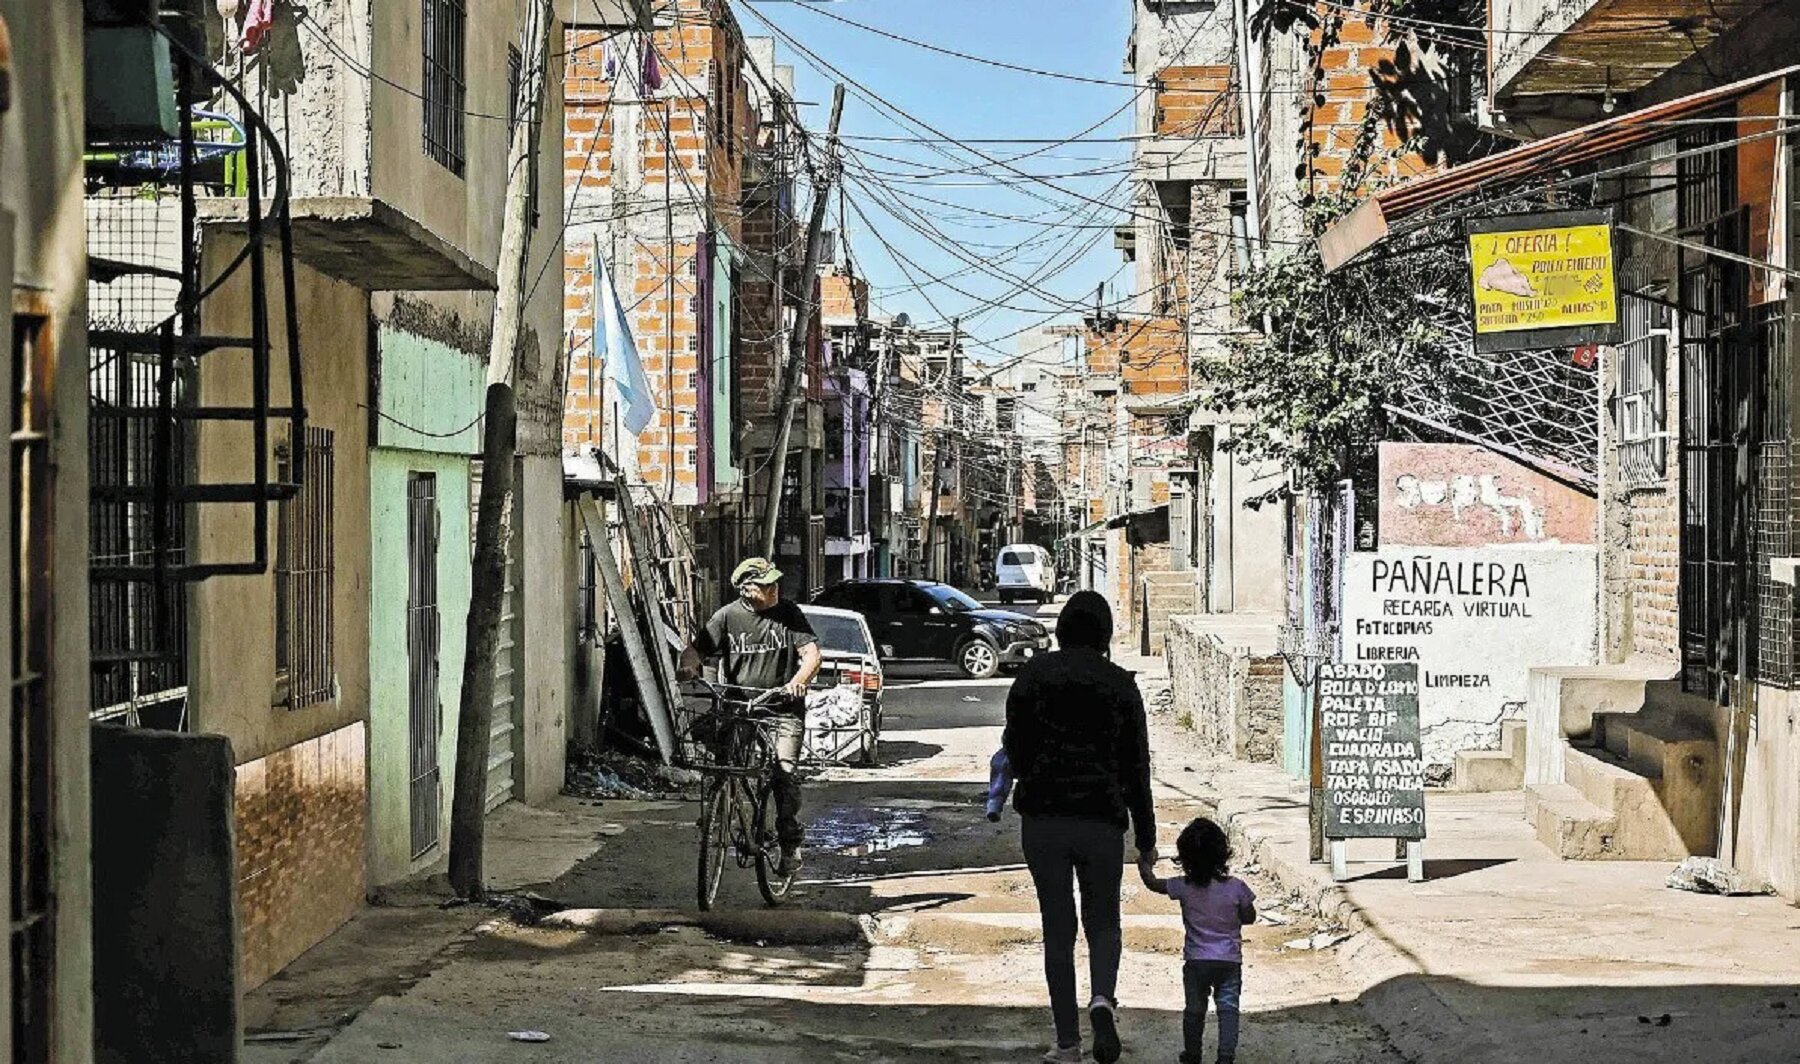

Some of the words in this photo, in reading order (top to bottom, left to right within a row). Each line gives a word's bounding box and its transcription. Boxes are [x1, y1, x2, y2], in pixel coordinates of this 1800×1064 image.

[1506, 234, 1558, 254] OFERTA
[1372, 555, 1530, 598] PAÑALERA
[1383, 599, 1453, 617] RECARGA
[1464, 602, 1532, 617] VIRTUAL
[1357, 644, 1420, 660] LIBRERIA
[1320, 664, 1386, 681] ASADO
[1425, 671, 1491, 687] LIMPIEZA
[1320, 680, 1363, 696] BOLA
[1320, 696, 1386, 712] PALETA
[1323, 712, 1360, 728] ROF
[1367, 711, 1398, 727] BIF
[1335, 727, 1383, 742] VACIO
[1328, 742, 1416, 758] CUADRADA
[1329, 759, 1370, 775] TAPA
[1372, 759, 1424, 776] ASADO
[1327, 775, 1370, 790] TAPA
